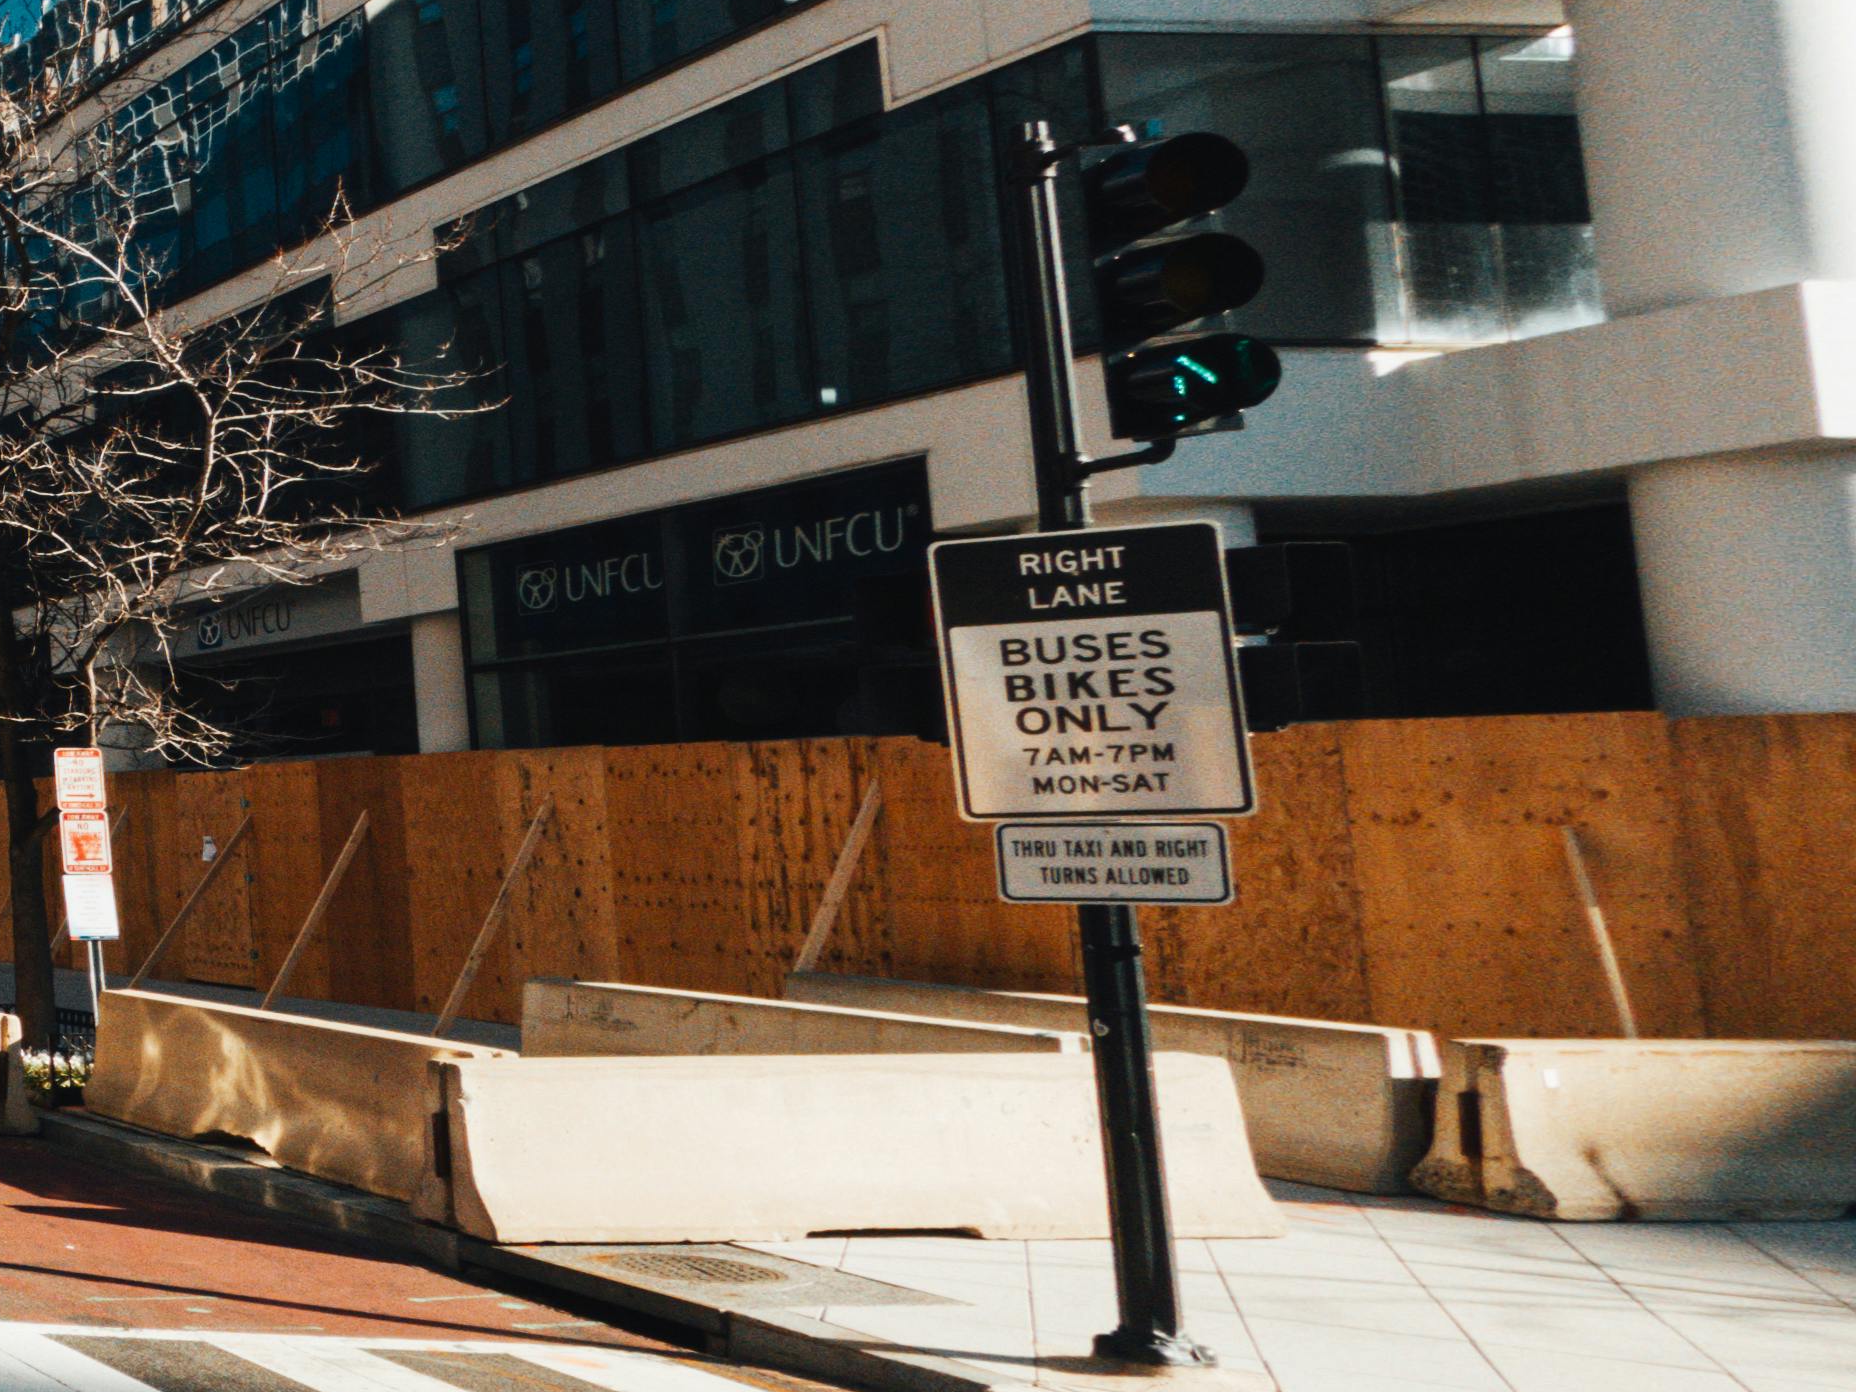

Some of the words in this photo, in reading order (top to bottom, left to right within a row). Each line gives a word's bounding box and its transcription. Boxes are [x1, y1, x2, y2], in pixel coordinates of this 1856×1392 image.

[1019, 546, 1126, 575] RIGHT
[1028, 581, 1127, 610] LANE
[227, 602, 290, 640] UNFCU
[999, 630, 1171, 668] BUSES
[1005, 667, 1175, 702] BIKES
[1015, 701, 1170, 735] ONLY
[1022, 743, 1176, 767] 7AM-7PM
[1032, 772, 1170, 795] MON-SAT
[1011, 840, 1057, 858] THRU
[1064, 839, 1102, 858] TAXI
[1110, 839, 1147, 857] AND
[1154, 839, 1208, 858] RIGHT
[1040, 867, 1097, 885] TURNS
[1105, 866, 1190, 885] ALLOWED
